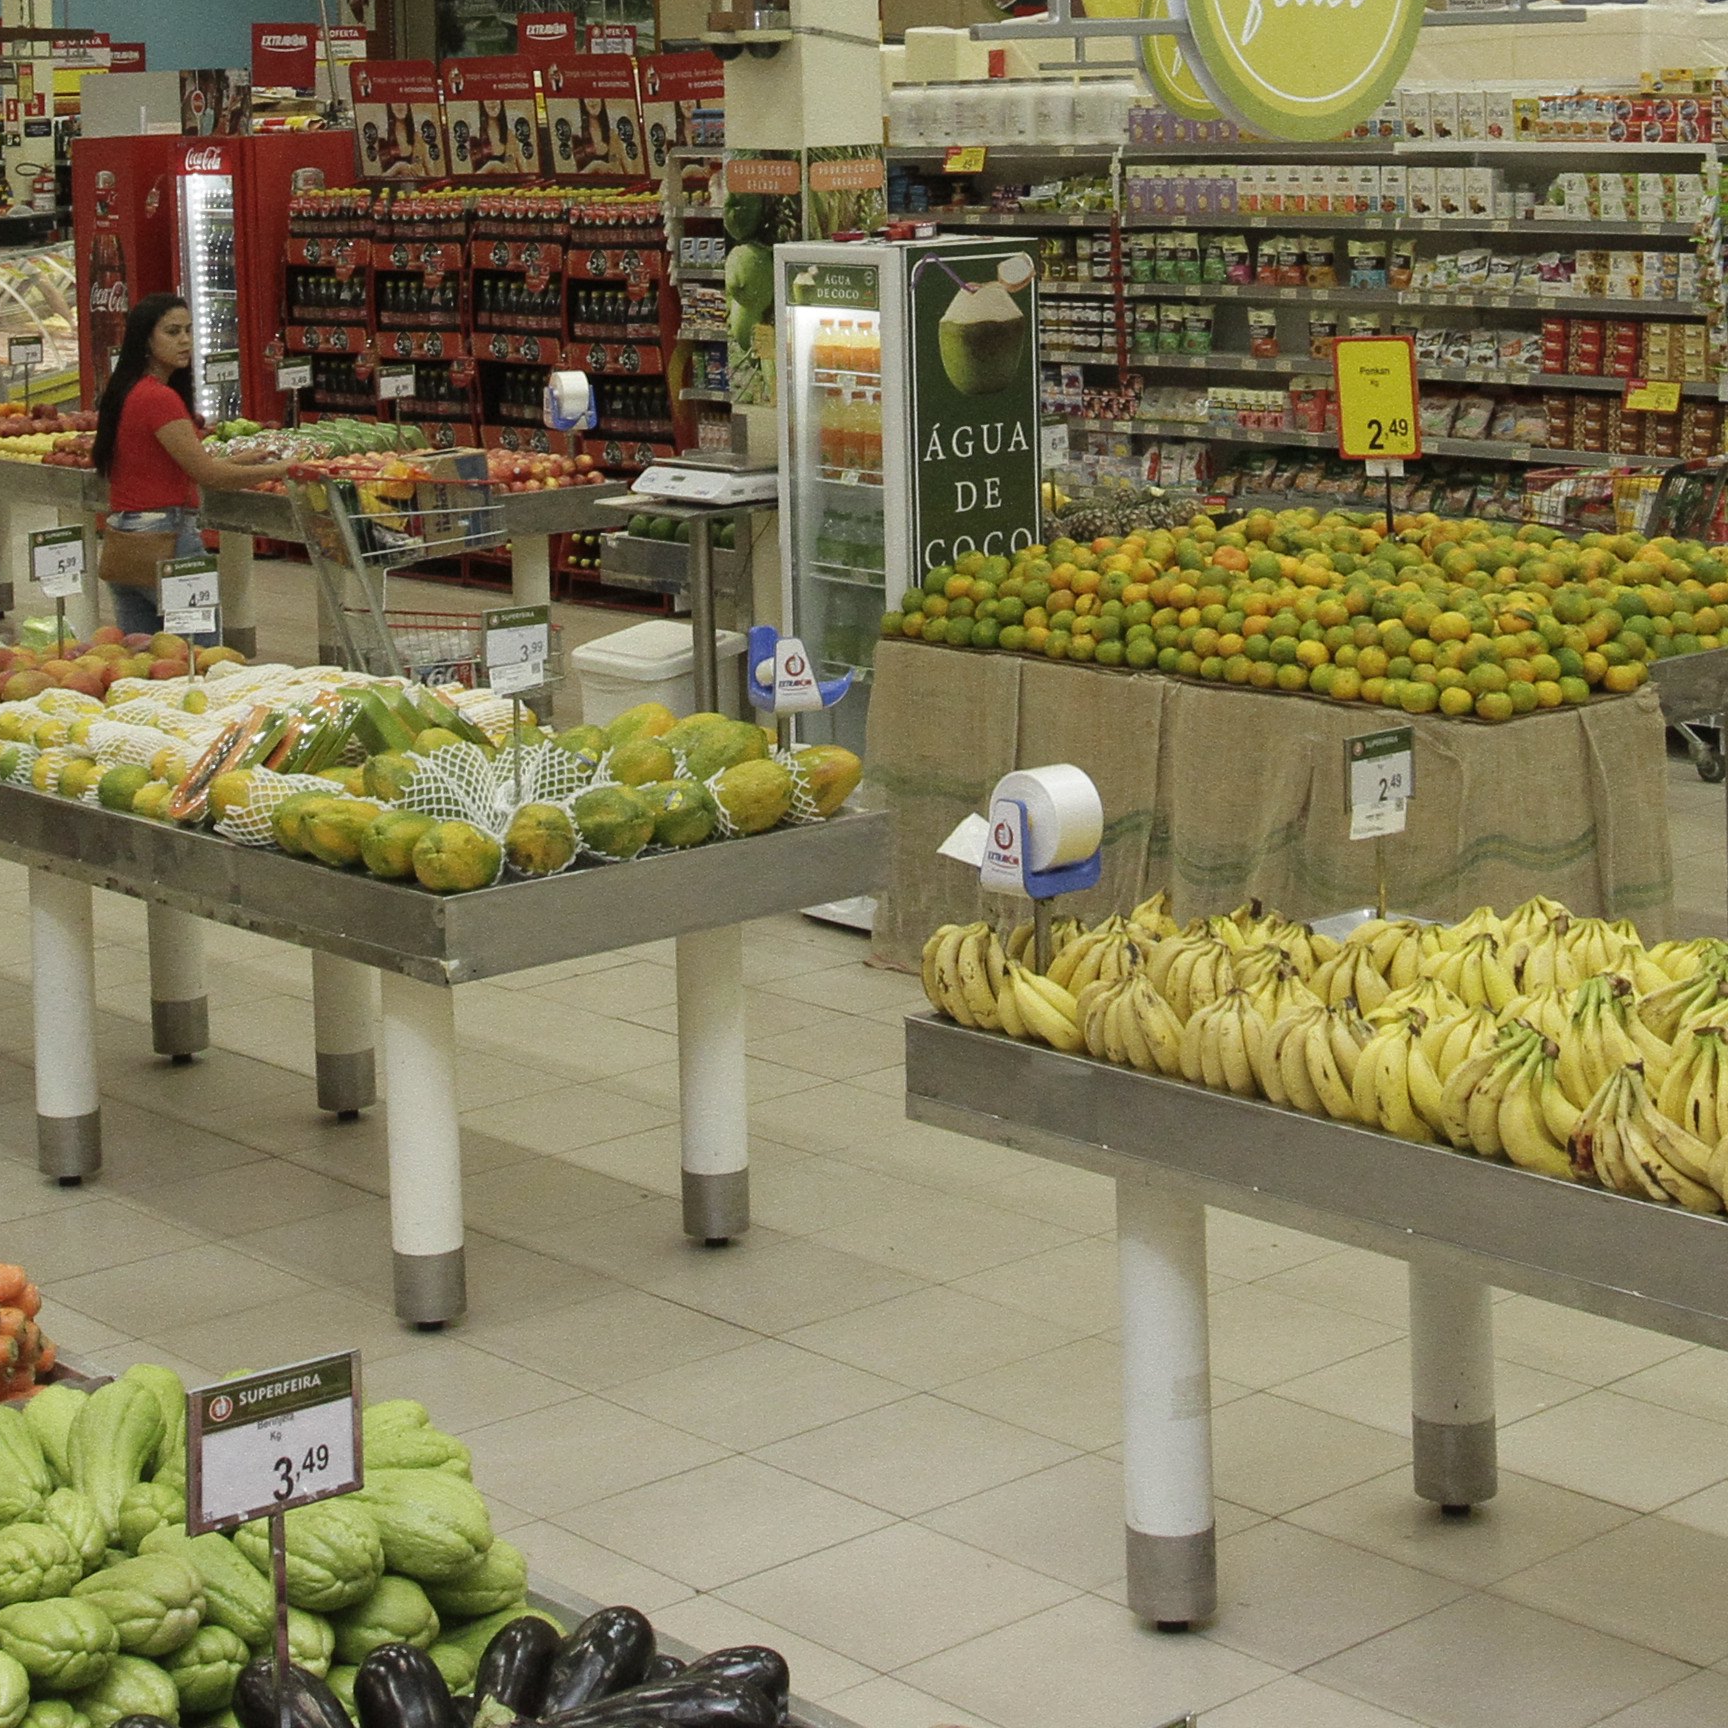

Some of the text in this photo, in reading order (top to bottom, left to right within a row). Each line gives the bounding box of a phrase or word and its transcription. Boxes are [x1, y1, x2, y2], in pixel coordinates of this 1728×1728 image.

[185, 146, 221, 171] Coca-Cola
[817, 289, 860, 300] DE COCO
[924, 421, 1029, 461] ÁGUA
[1367, 418, 1408, 450] 2,49
[955, 477, 1002, 512] DE
[925, 528, 1032, 570] COCO
[520, 640, 544, 663] 3,99
[1379, 773, 1403, 802] 2,49
[238, 1373, 322, 1406] SUPERFEIRA
[269, 1431, 283, 1443] Kg
[273, 1443, 330, 1502] 3,49
